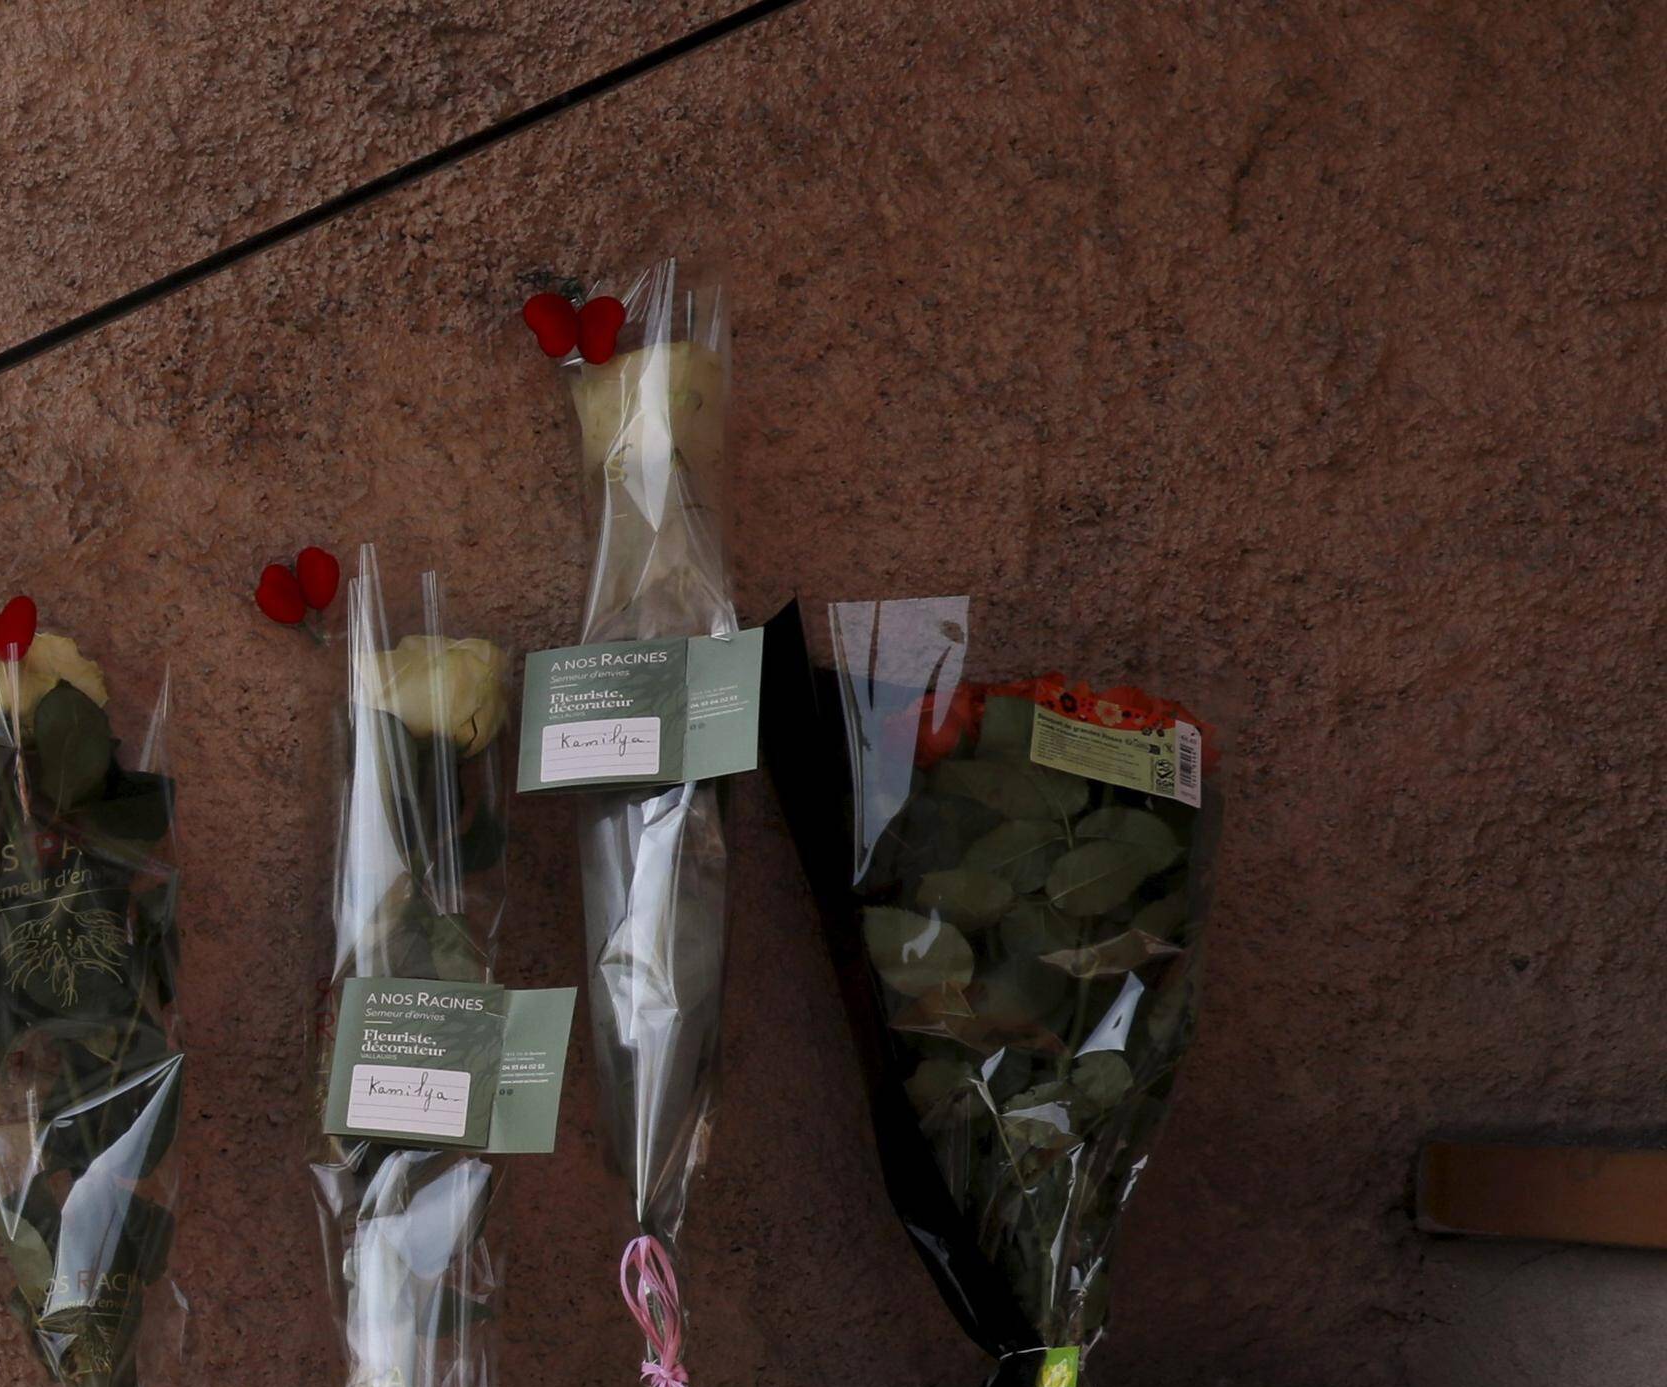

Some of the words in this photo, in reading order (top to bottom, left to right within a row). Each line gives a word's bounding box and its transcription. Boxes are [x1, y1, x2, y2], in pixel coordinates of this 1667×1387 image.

[550, 661, 561, 673] A
[564, 656, 597, 670] NOS
[601, 651, 668, 667] RACINES
[550, 672, 588, 684] Semeur
[589, 669, 630, 680] d'envies
[549, 688, 624, 705] Fleuriste,
[548, 697, 634, 715] décorateur
[366, 992, 378, 1004] A
[380, 993, 413, 1006] NOS
[417, 992, 484, 1011] RACINES
[364, 1007, 403, 1019] Semeur
[404, 1008, 446, 1022] d'envies
[362, 1029, 437, 1046] Fleuriste,
[361, 1041, 447, 1057] décorateur
[368, 1072, 448, 1112] Kamilya
